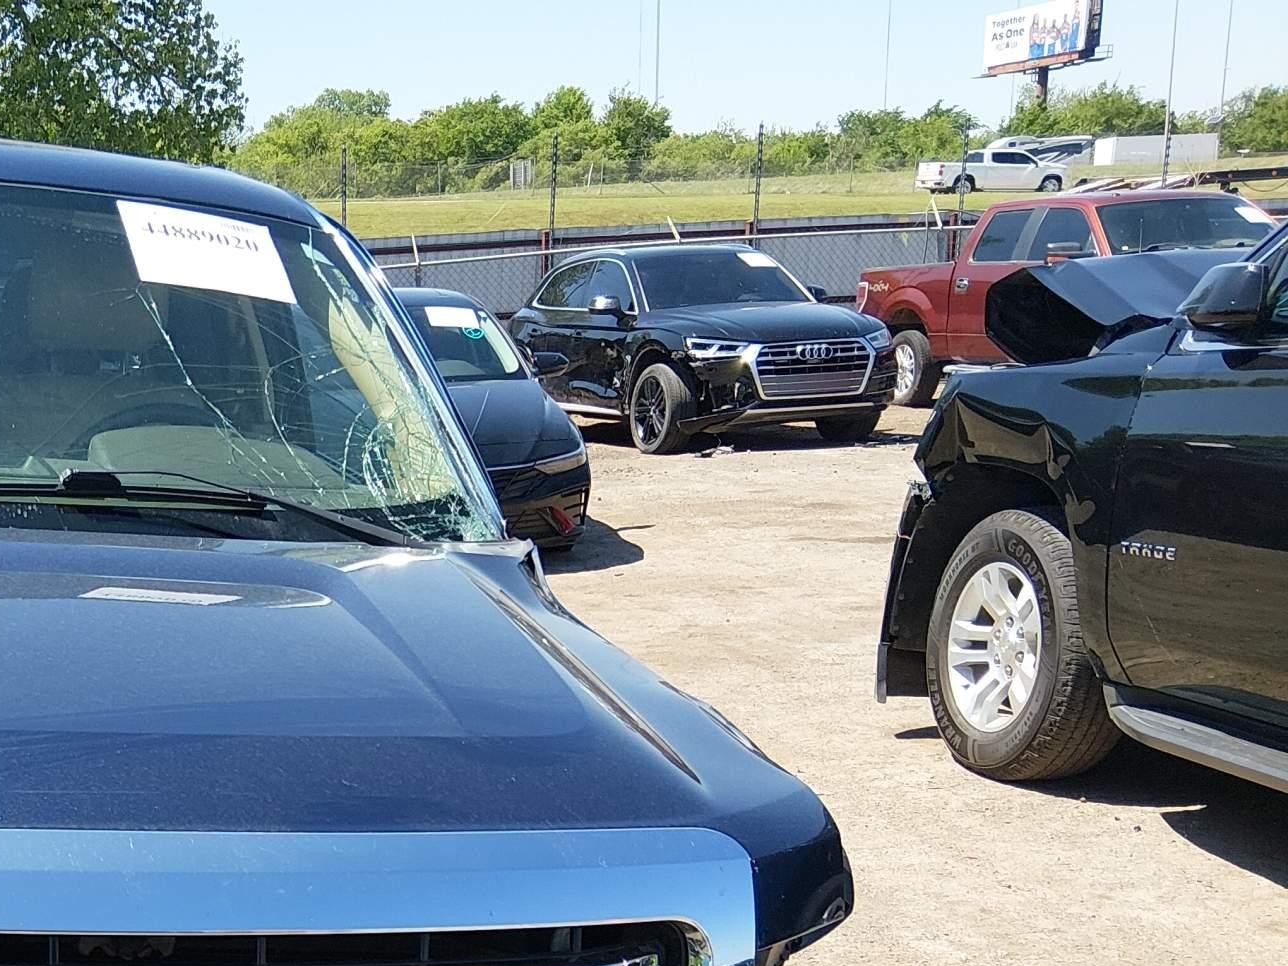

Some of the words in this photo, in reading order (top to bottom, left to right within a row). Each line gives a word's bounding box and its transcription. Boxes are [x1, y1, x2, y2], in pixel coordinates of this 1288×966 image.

[991, 16, 1026, 29] Together
[991, 32, 1004, 41] As
[1005, 28, 1025, 39] One
[142, 221, 259, 252] 44889020
[1120, 541, 1177, 561] TAHOE
